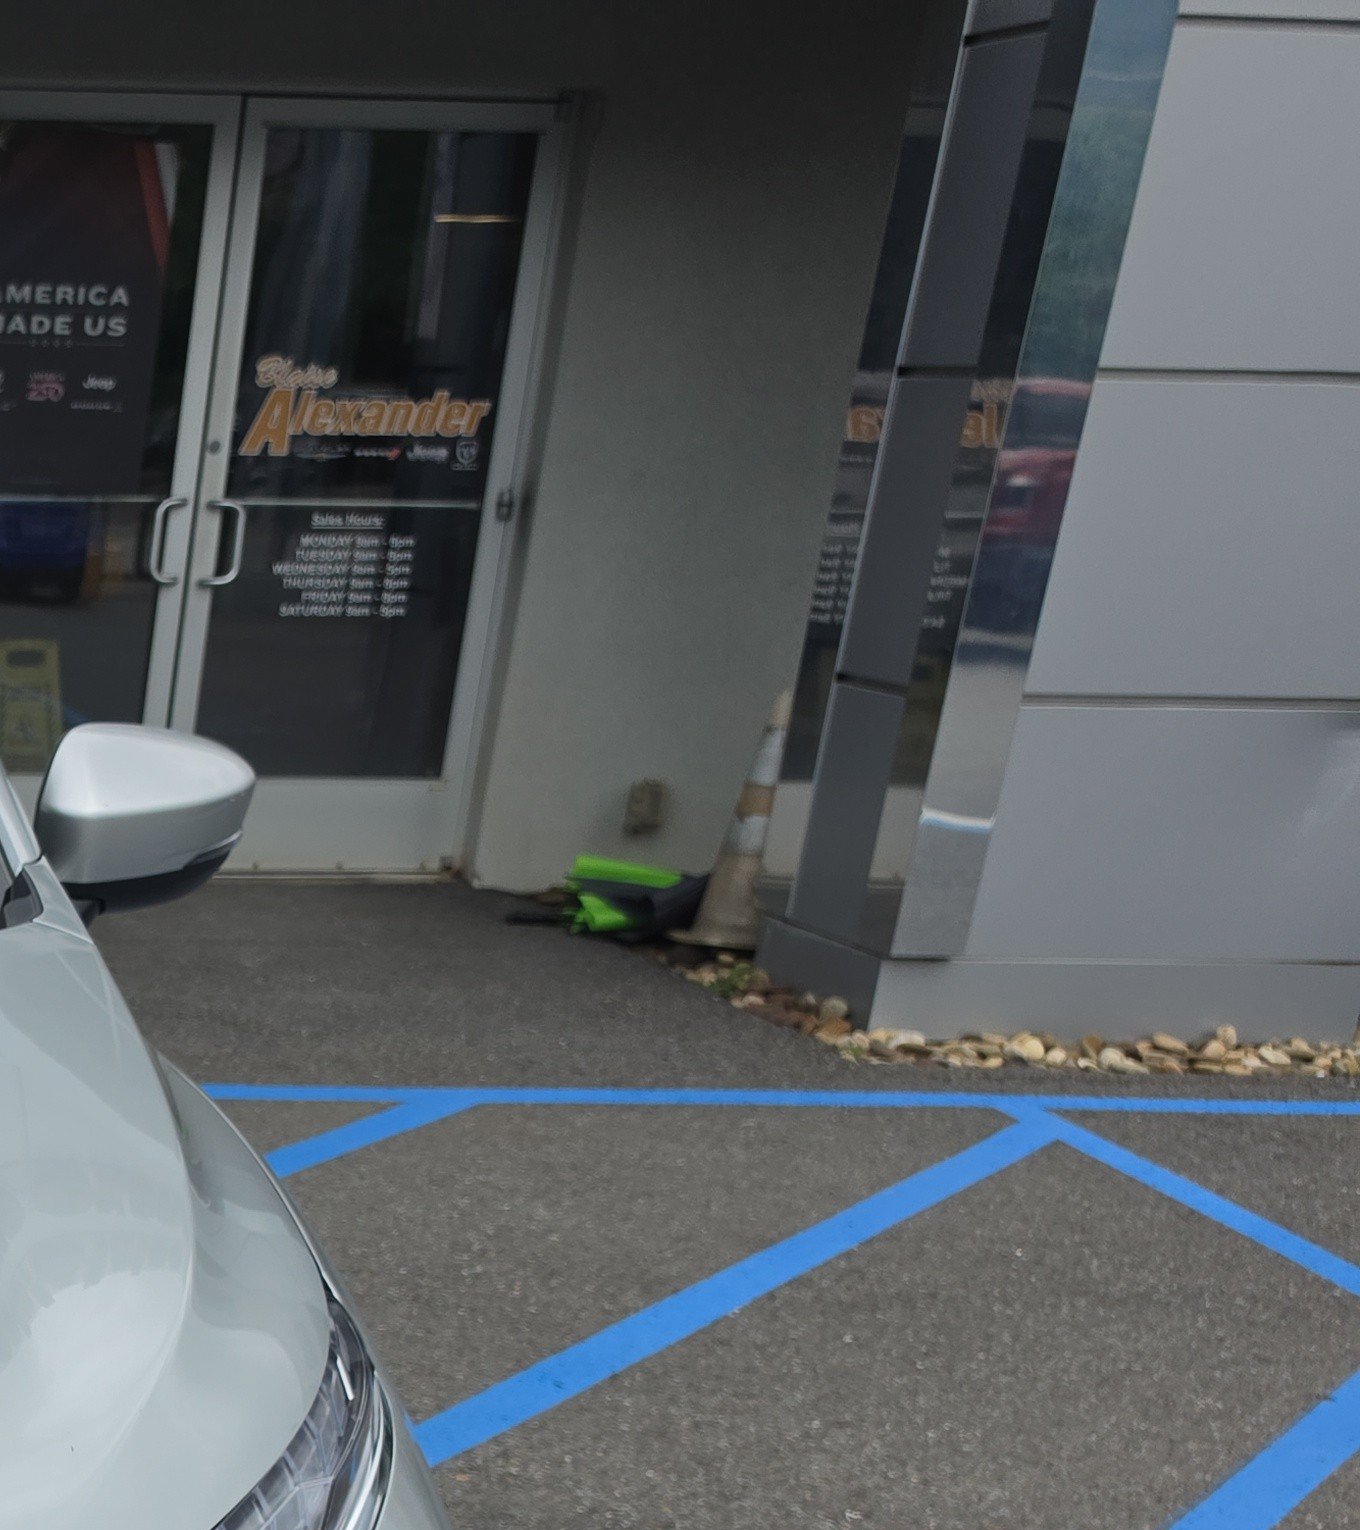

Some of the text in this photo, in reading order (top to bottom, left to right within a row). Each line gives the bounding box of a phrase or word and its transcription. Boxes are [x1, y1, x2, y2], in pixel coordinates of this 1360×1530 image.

[83, 315, 128, 337] US
[238, 388, 492, 456] Alexander
[311, 512, 343, 527] Sales
